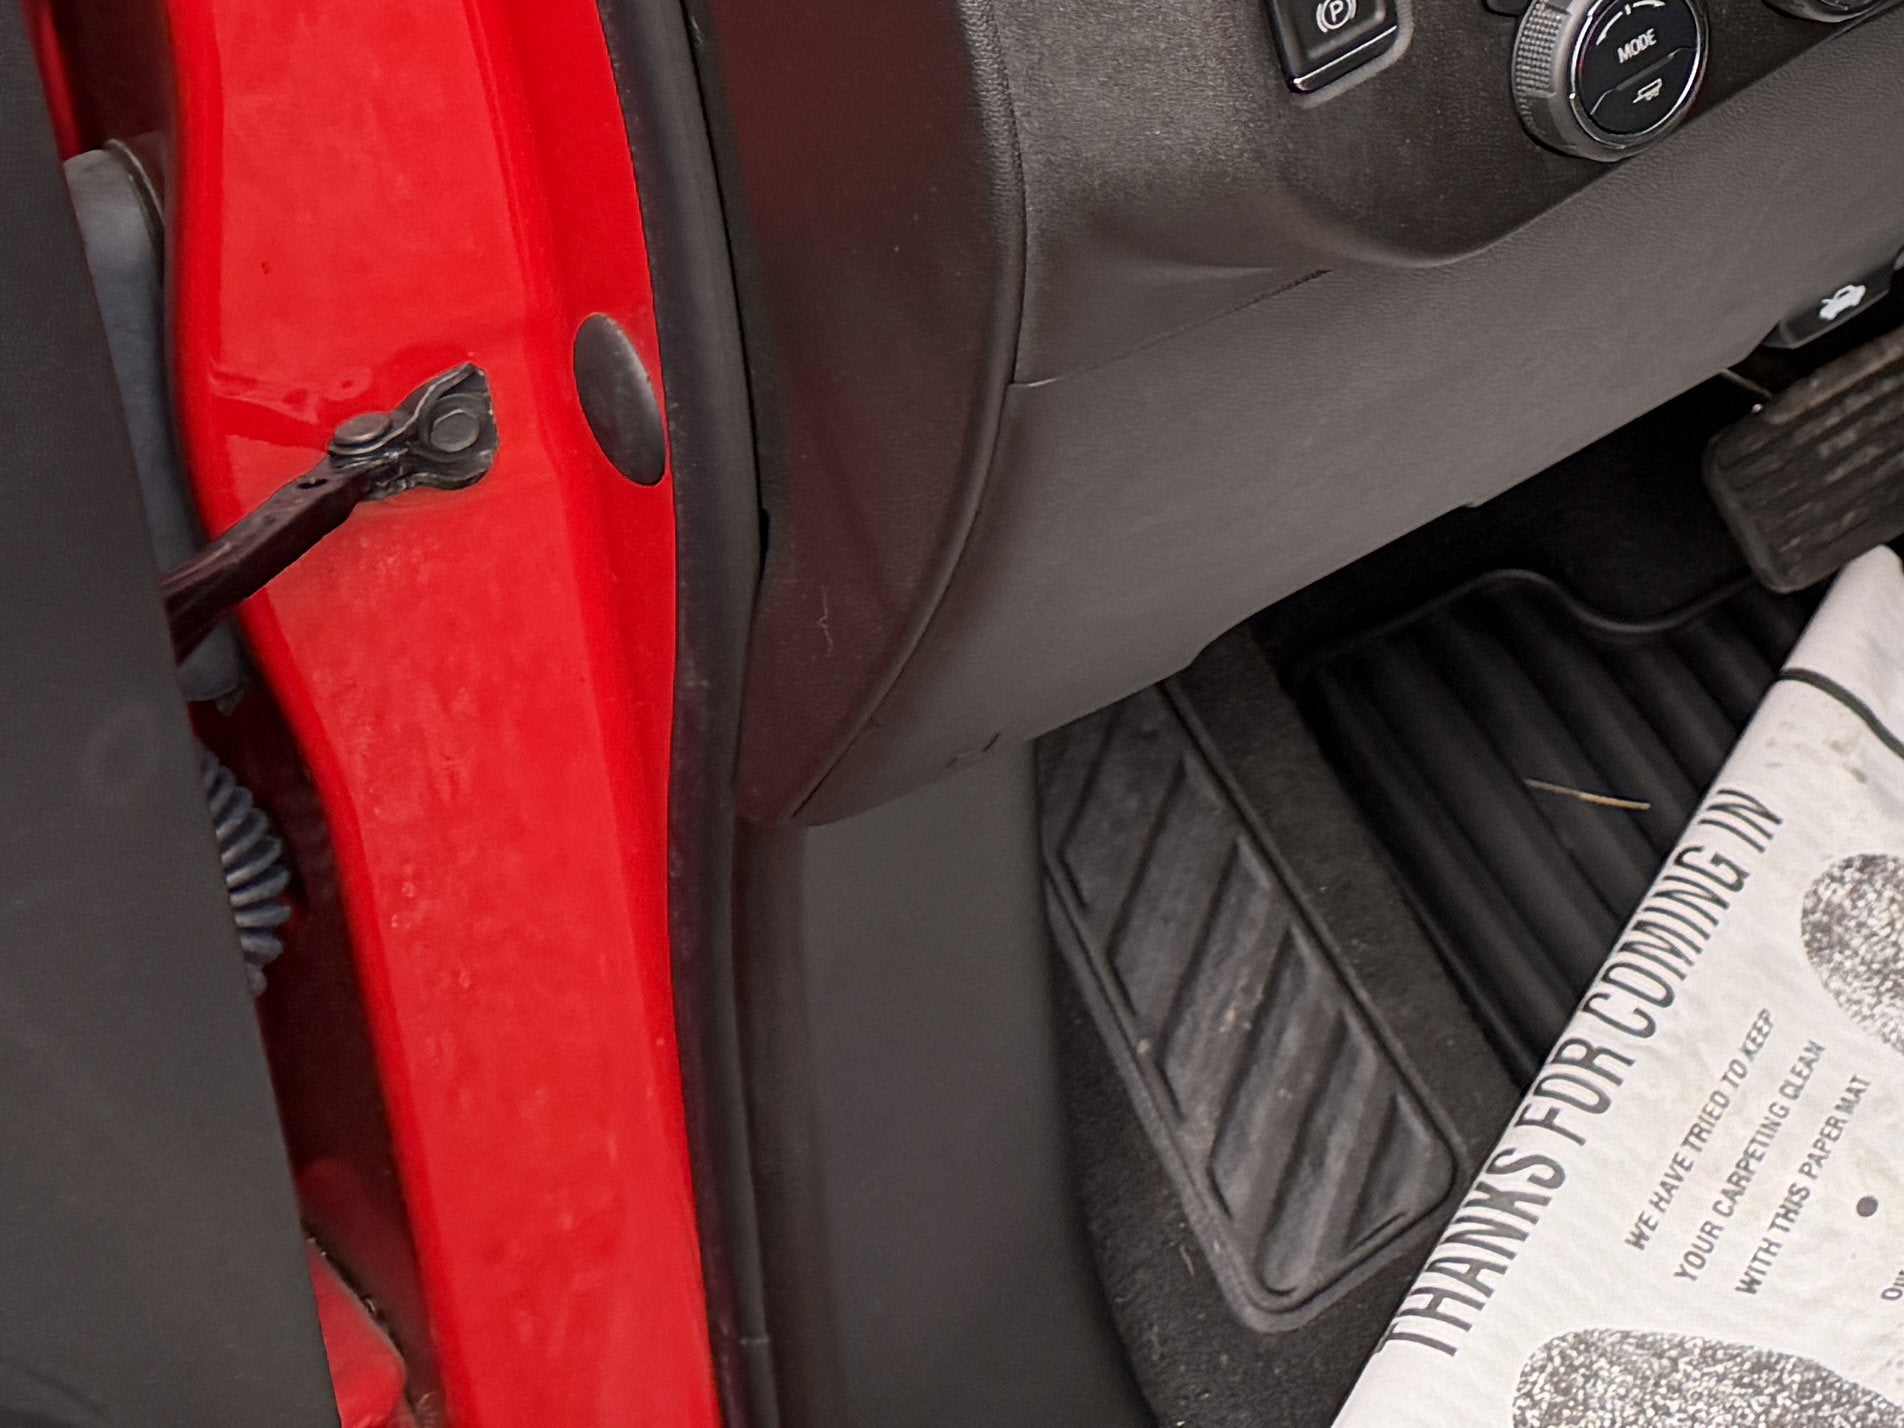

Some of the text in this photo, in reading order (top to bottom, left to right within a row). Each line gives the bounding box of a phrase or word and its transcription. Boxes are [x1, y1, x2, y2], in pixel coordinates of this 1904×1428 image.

[1617, 27, 1657, 63] MODE
[1375, 788, 1784, 1357] THANKS FOR COMING IN
[1624, 1008, 1774, 1251] WE HAVE TRIED TO KEEP
[1673, 1039, 1826, 1282] YOUR CARPETING CLEAN
[1734, 1074, 1872, 1295] WITH THIS PAPER MAT
